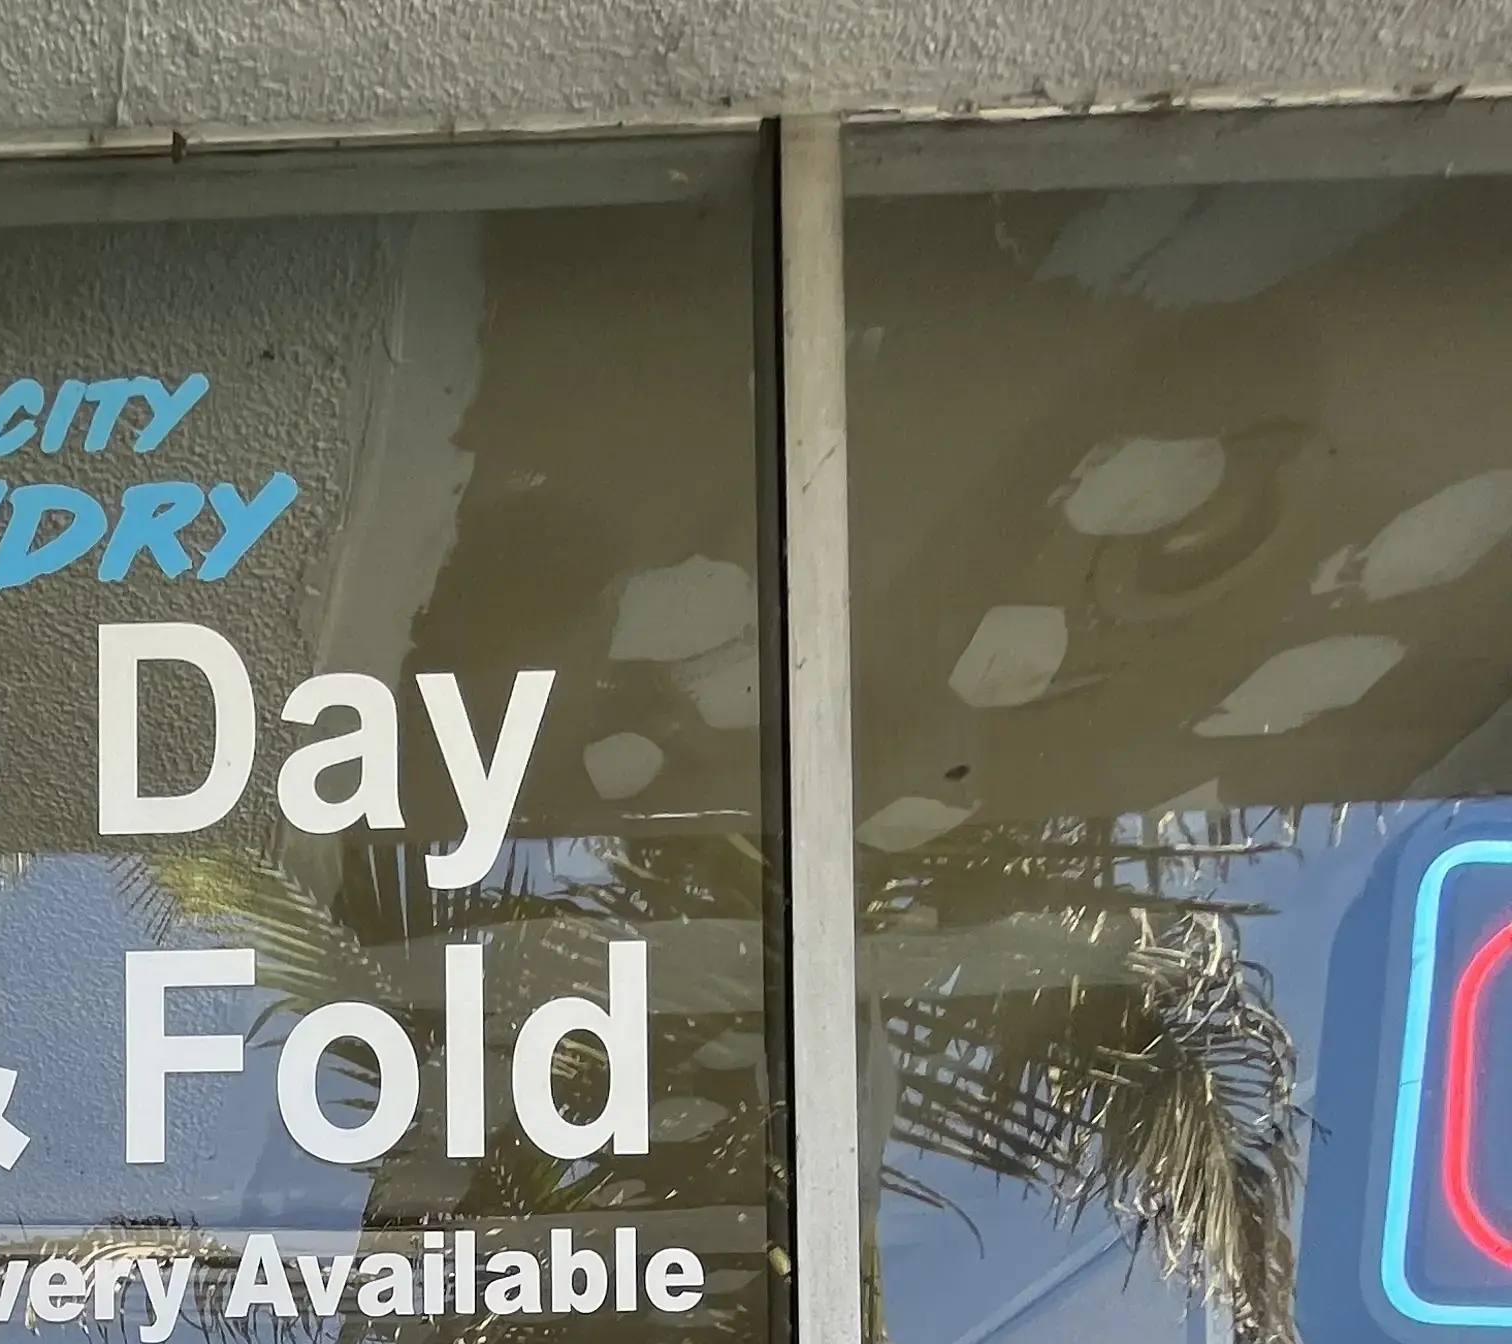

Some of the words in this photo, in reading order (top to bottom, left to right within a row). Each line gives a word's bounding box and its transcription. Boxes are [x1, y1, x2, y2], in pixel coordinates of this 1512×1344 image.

[95, 622, 556, 889] Day
[124, 938, 653, 1167] Fold
[227, 1224, 705, 1321] Available
